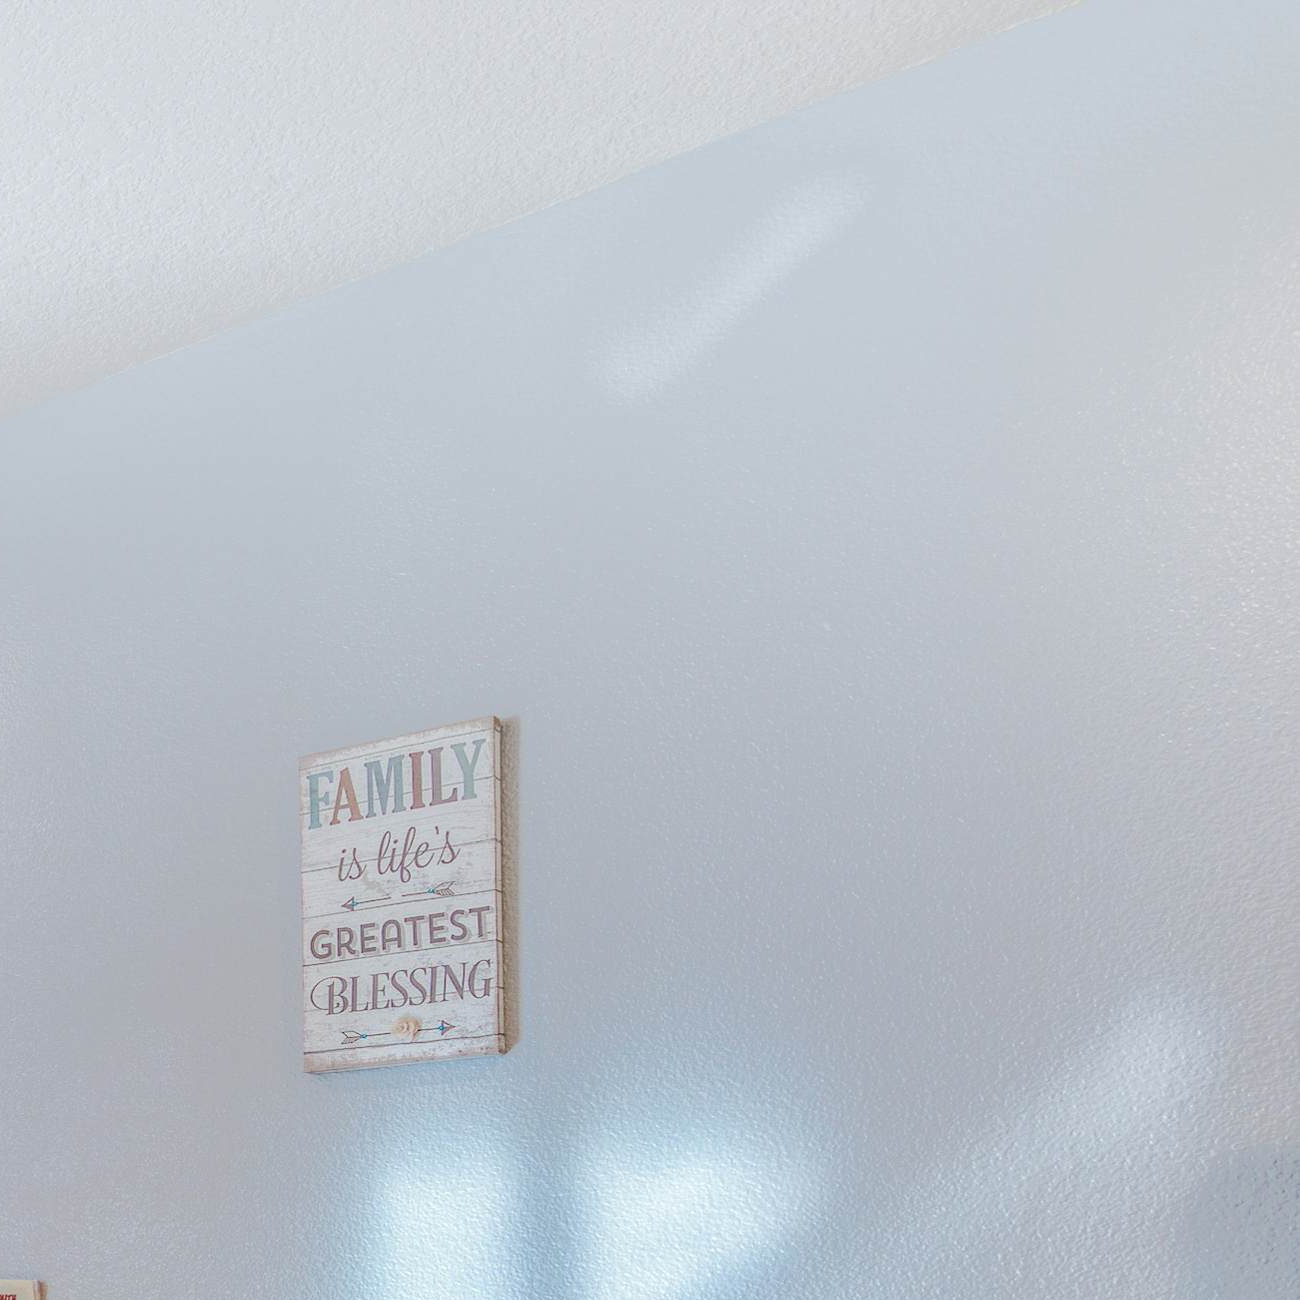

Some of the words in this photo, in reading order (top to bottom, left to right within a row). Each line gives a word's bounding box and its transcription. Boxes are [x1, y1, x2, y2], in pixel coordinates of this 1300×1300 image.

[305, 738, 487, 830] FAMILY
[337, 848, 367, 882] is
[377, 825, 461, 884] life's
[309, 905, 491, 959] GREATEST
[310, 958, 494, 1016] BLESSING
